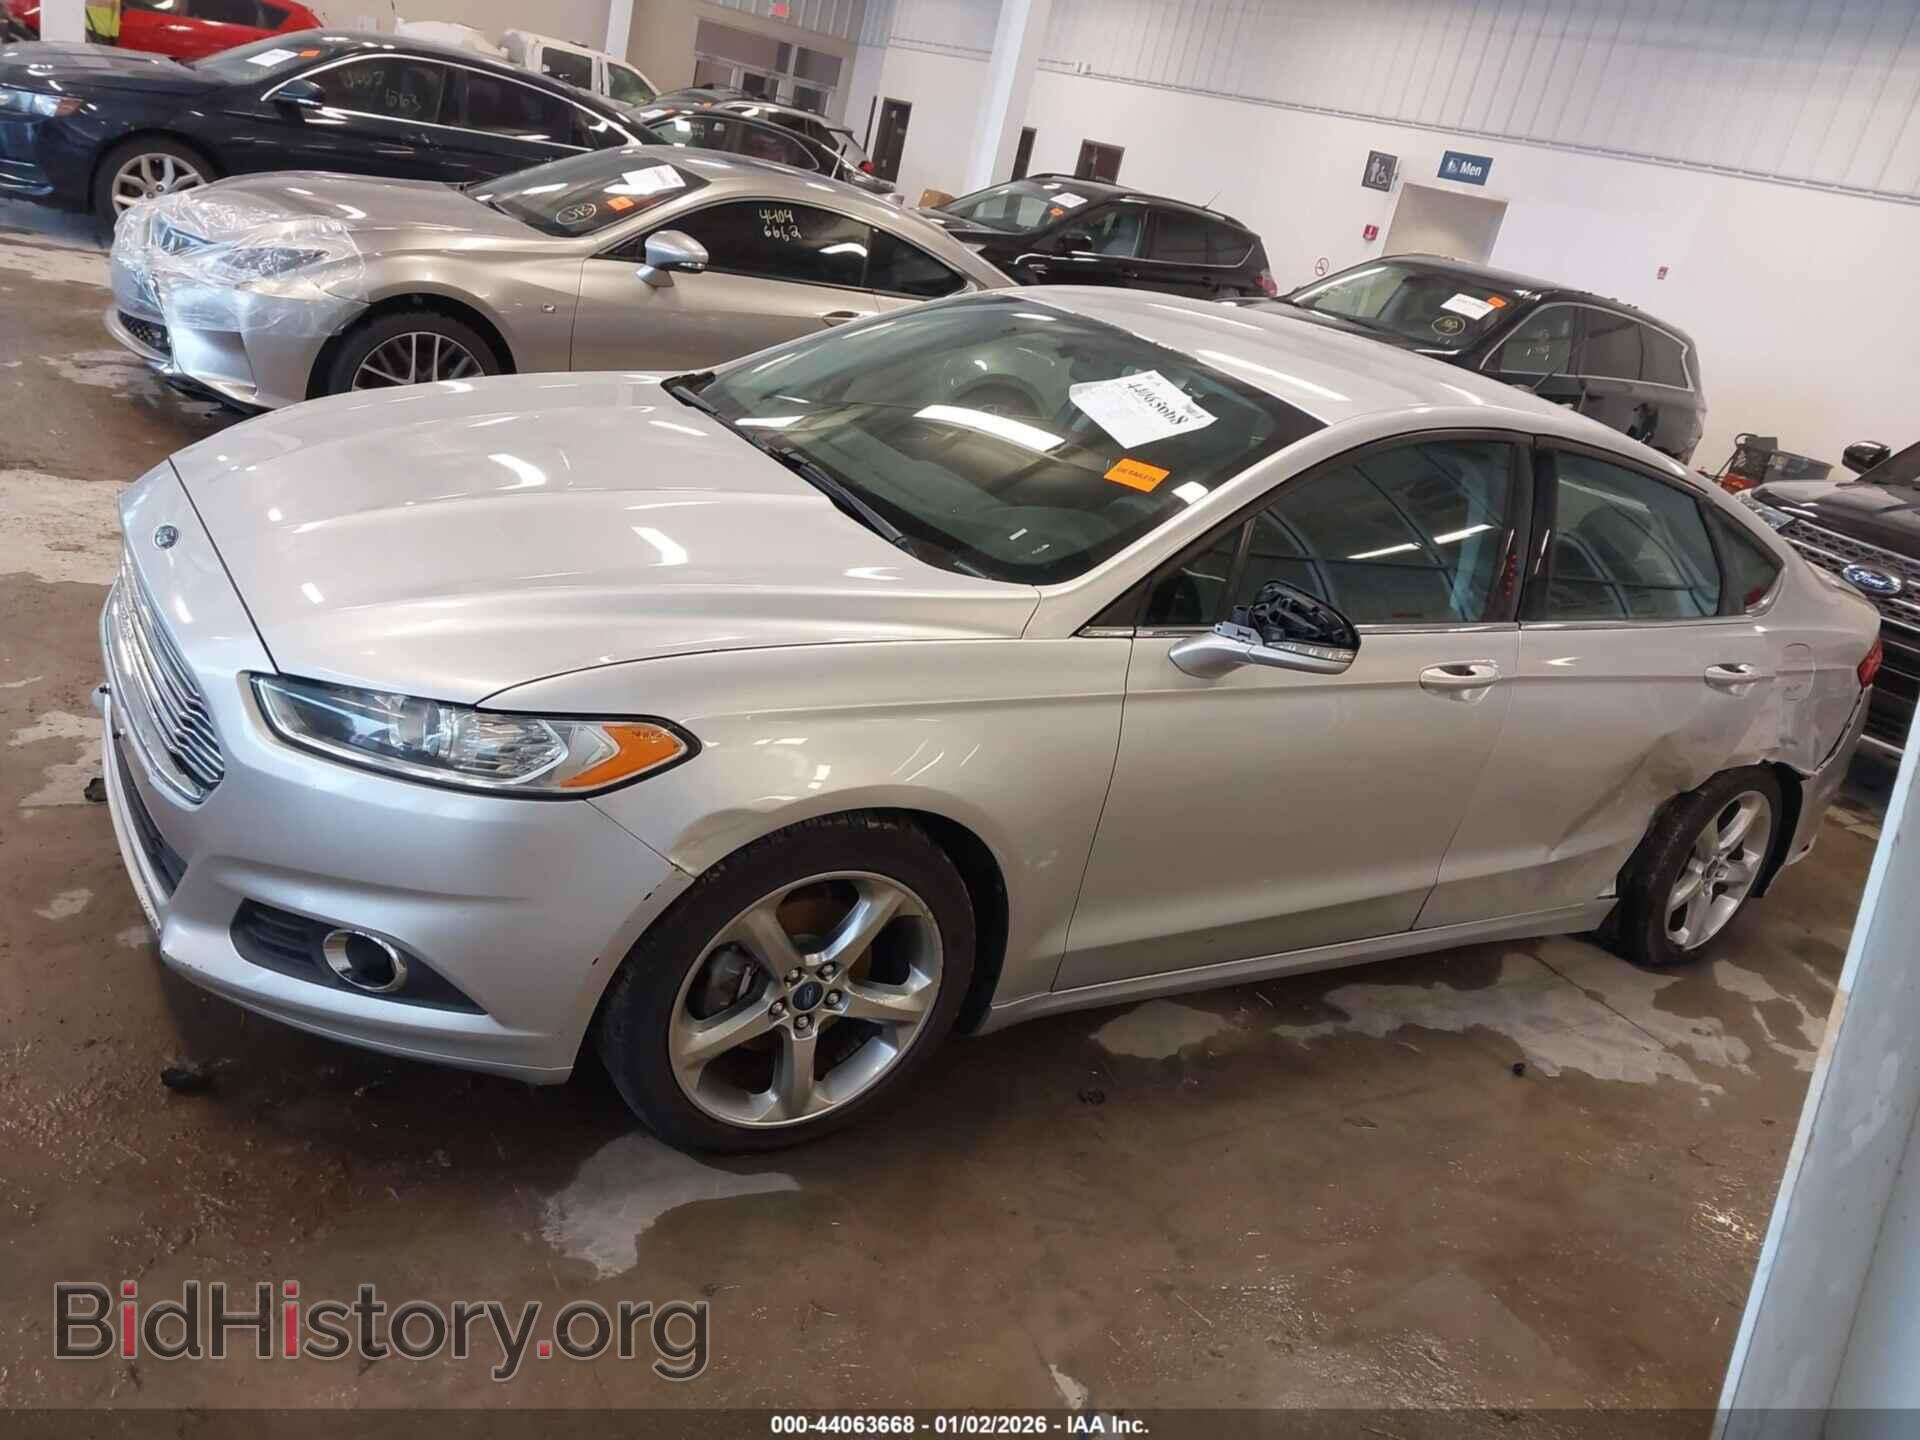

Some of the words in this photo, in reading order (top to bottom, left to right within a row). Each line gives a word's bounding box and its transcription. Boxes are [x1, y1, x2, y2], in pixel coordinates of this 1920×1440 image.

[1459, 160, 1482, 177] Men
[759, 208, 794, 225] 4404
[763, 224, 802, 242] 6662
